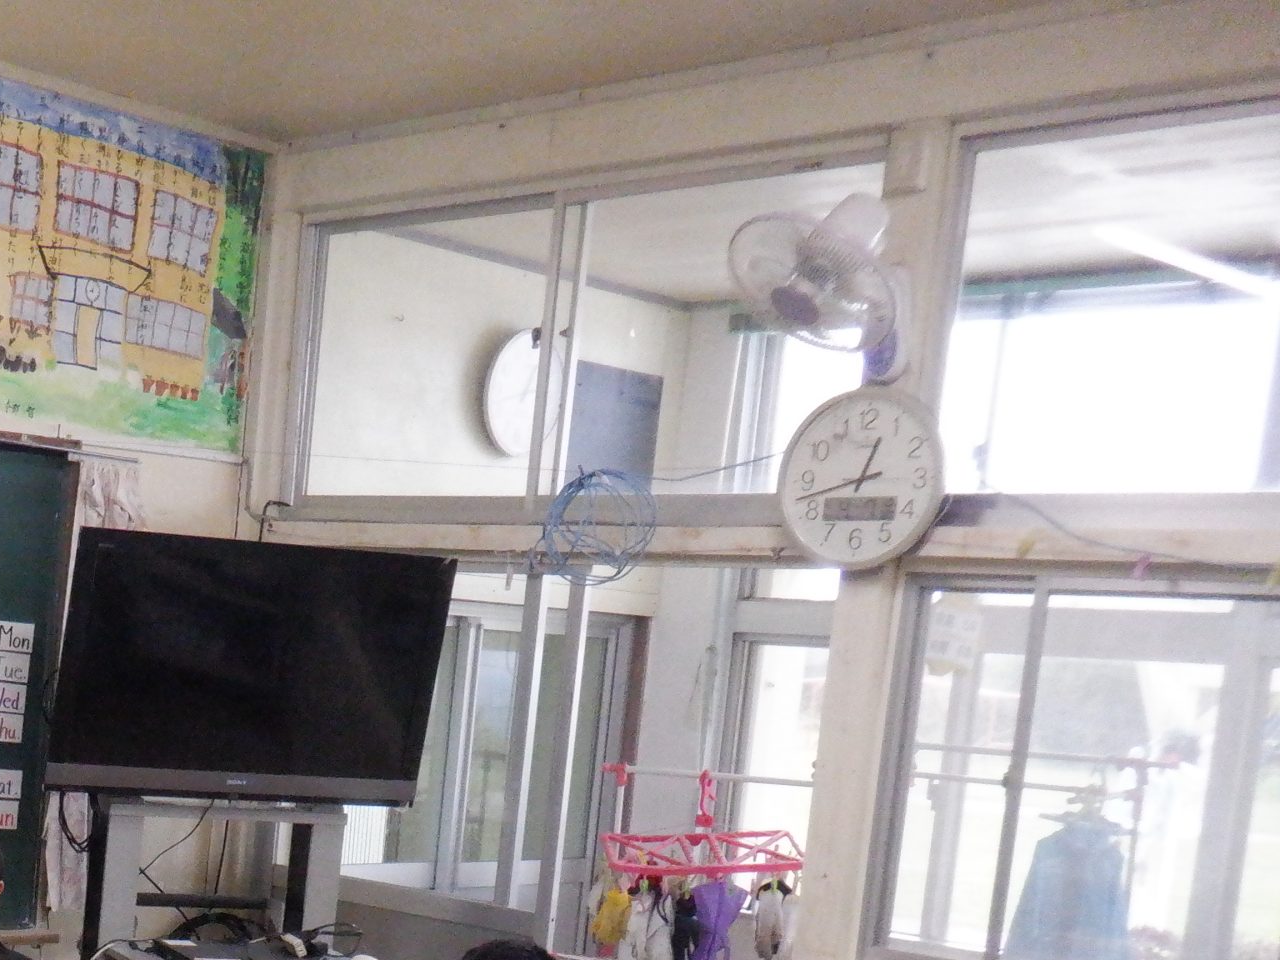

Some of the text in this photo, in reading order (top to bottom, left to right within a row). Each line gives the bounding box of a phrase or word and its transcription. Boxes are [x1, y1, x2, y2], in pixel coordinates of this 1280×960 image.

[859, 408, 880, 431] 12
[892, 416, 900, 436] 1
[808, 440, 830, 462] 10
[908, 436, 926, 459] 2
[801, 470, 815, 491] 9
[912, 467, 928, 489] 3
[805, 500, 819, 521] 8
[899, 499, 915, 519] 4
[824, 523, 836, 542] 7
[848, 528, 863, 550] 6
[878, 522, 892, 543] 5
